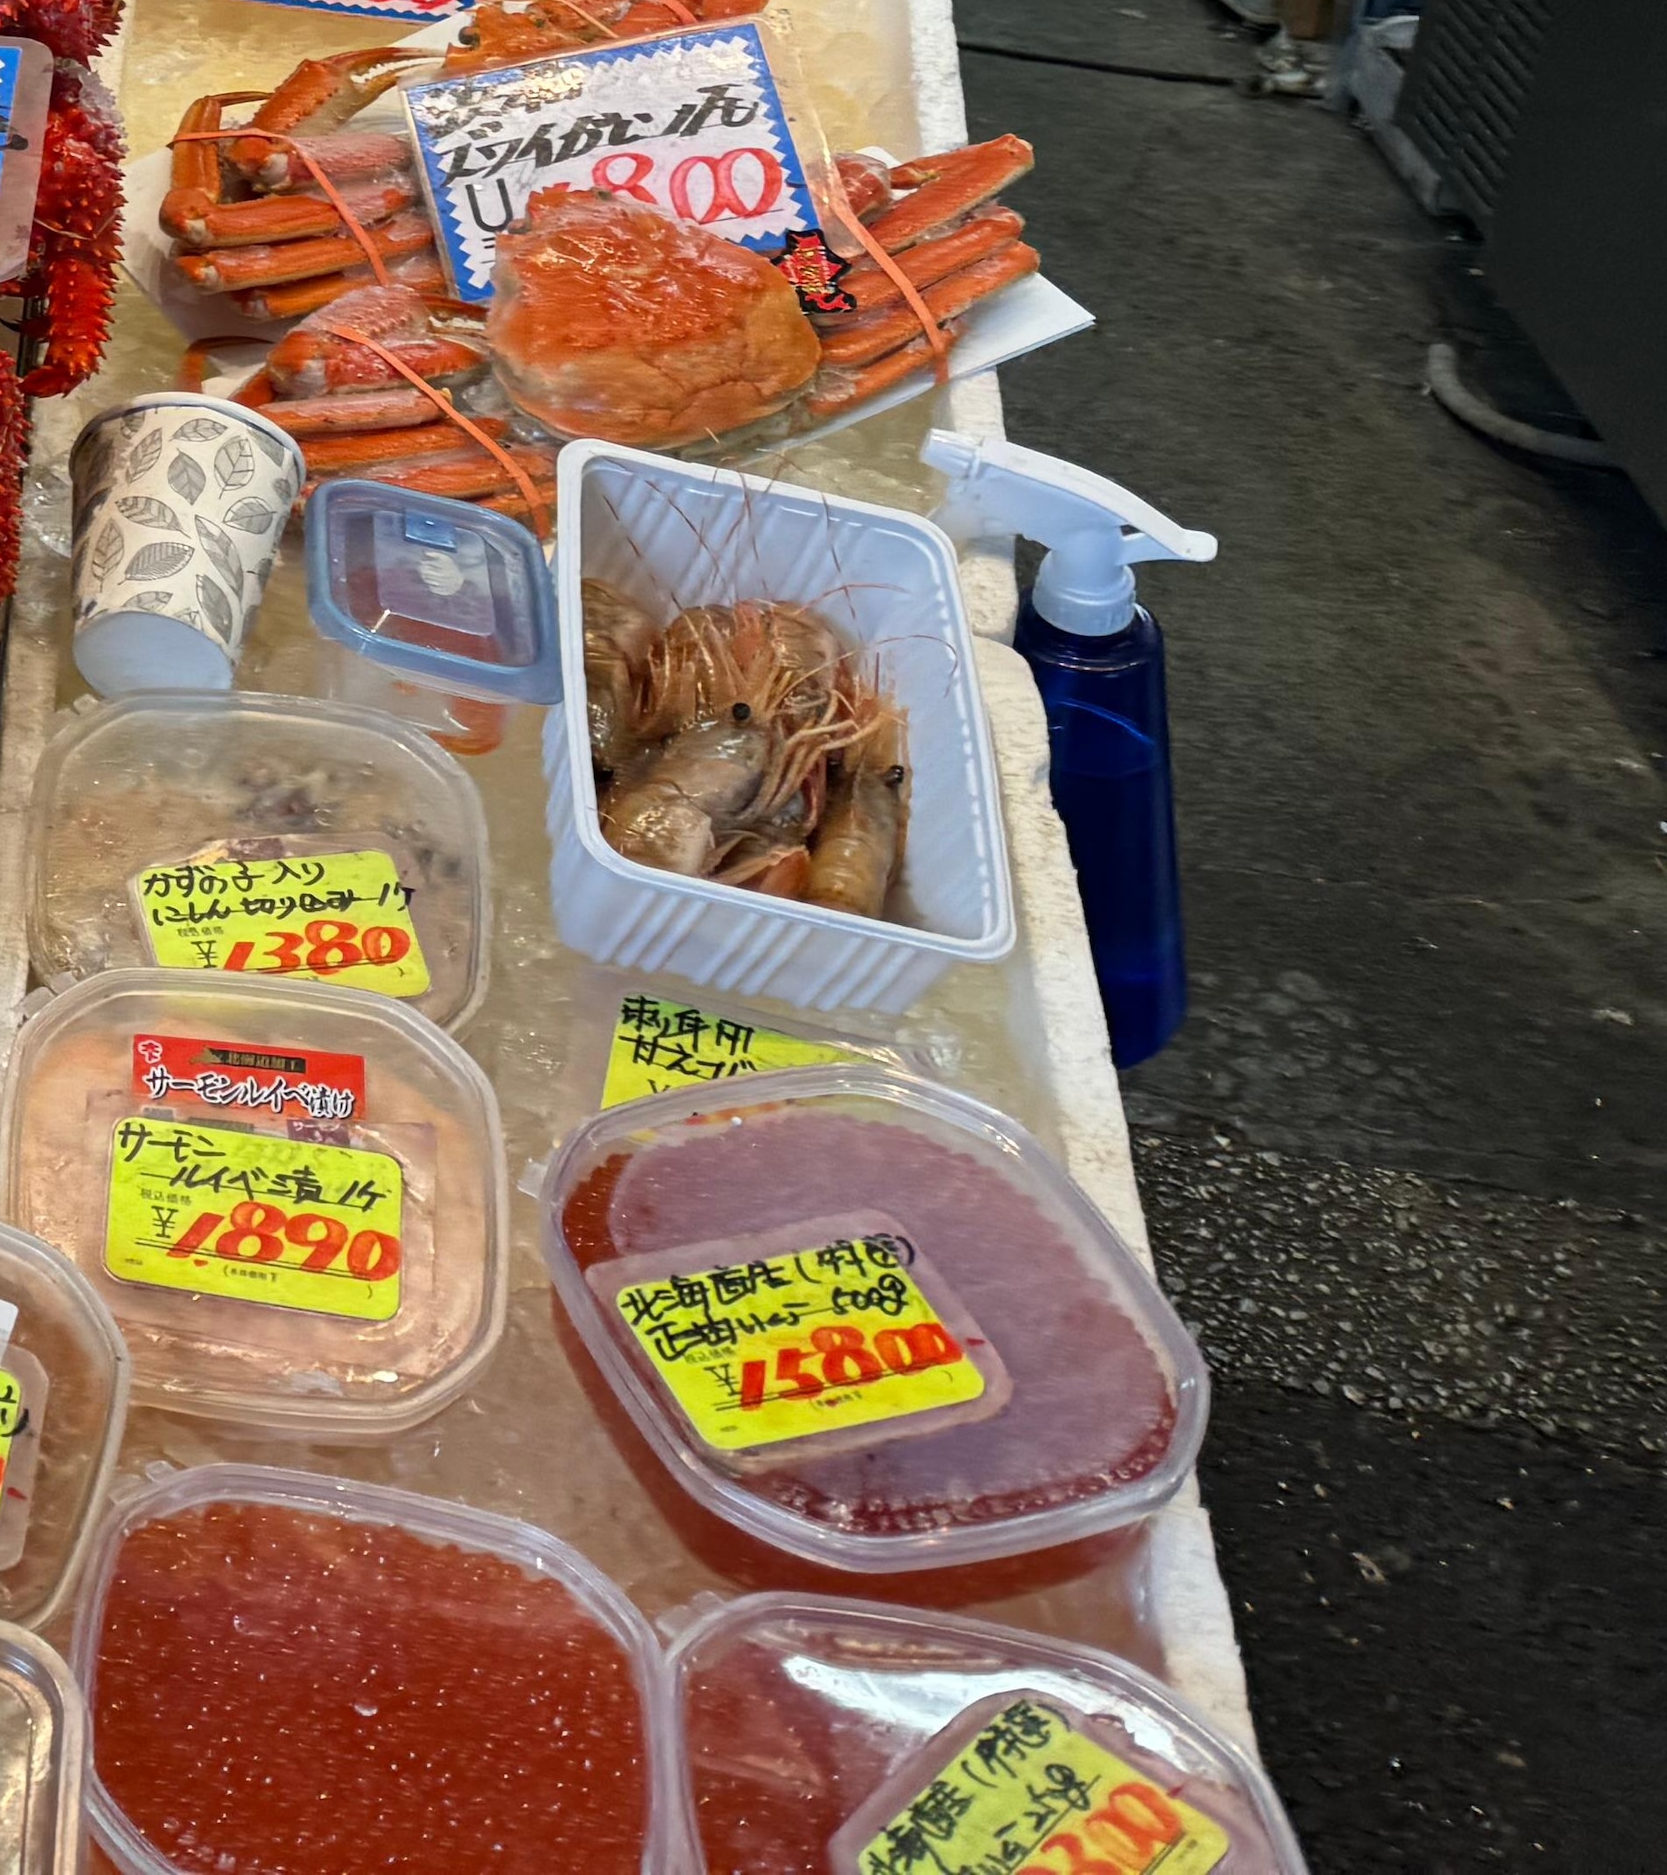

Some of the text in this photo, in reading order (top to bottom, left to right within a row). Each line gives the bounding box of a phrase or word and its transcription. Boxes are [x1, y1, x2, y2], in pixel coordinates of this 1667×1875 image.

[144, 1065, 355, 1120] サーモンルイベ漬け
[118, 1121, 226, 1163] サーモン
